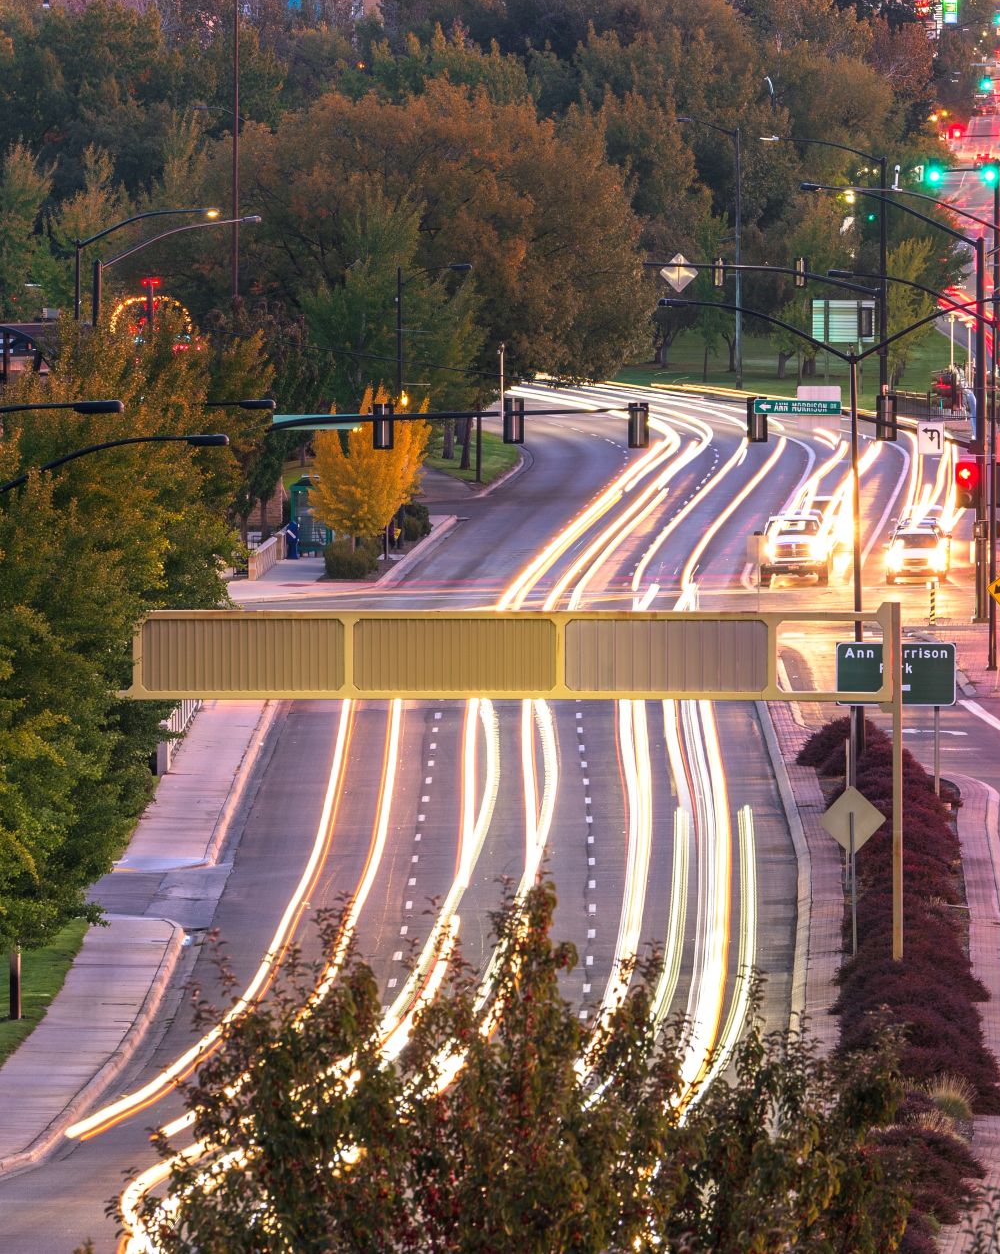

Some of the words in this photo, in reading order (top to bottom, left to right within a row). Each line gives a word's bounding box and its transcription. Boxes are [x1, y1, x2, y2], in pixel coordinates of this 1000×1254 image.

[774, 402, 788, 412] ANN
[791, 402, 828, 412] MORRISON
[844, 647, 874, 658] Ann
[900, 647, 948, 658] rrison
